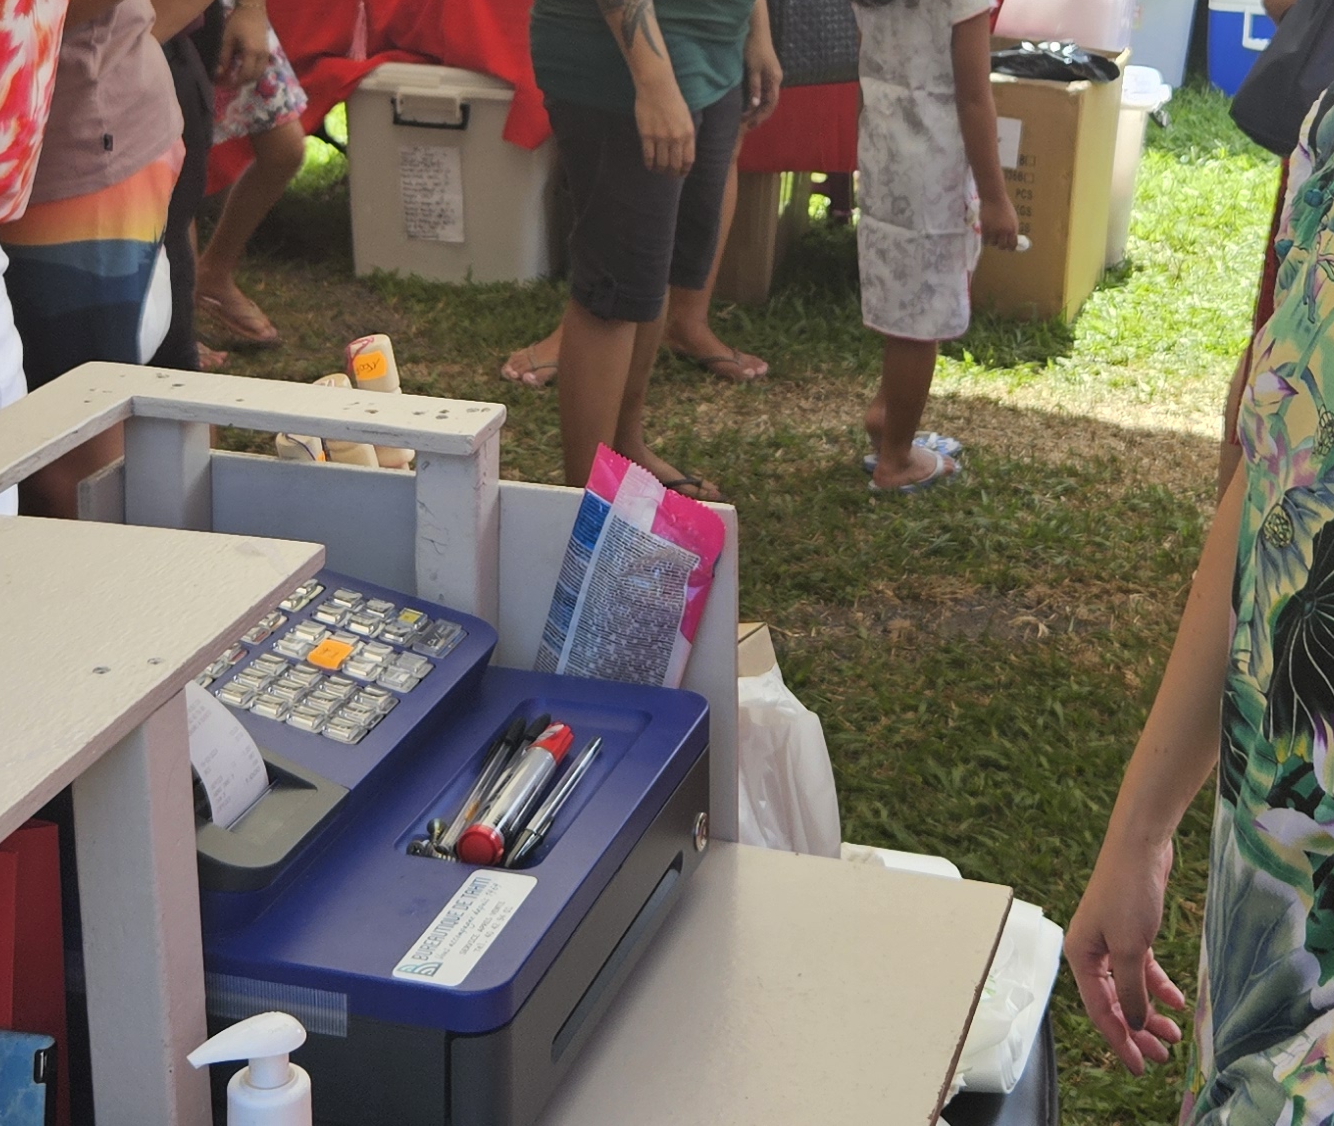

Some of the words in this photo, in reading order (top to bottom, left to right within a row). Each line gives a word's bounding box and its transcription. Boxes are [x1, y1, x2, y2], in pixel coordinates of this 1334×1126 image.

[460, 877, 492, 900] TAHITI
[452, 899, 474, 911] DE
[411, 910, 465, 961] BUREAUTIQUE
